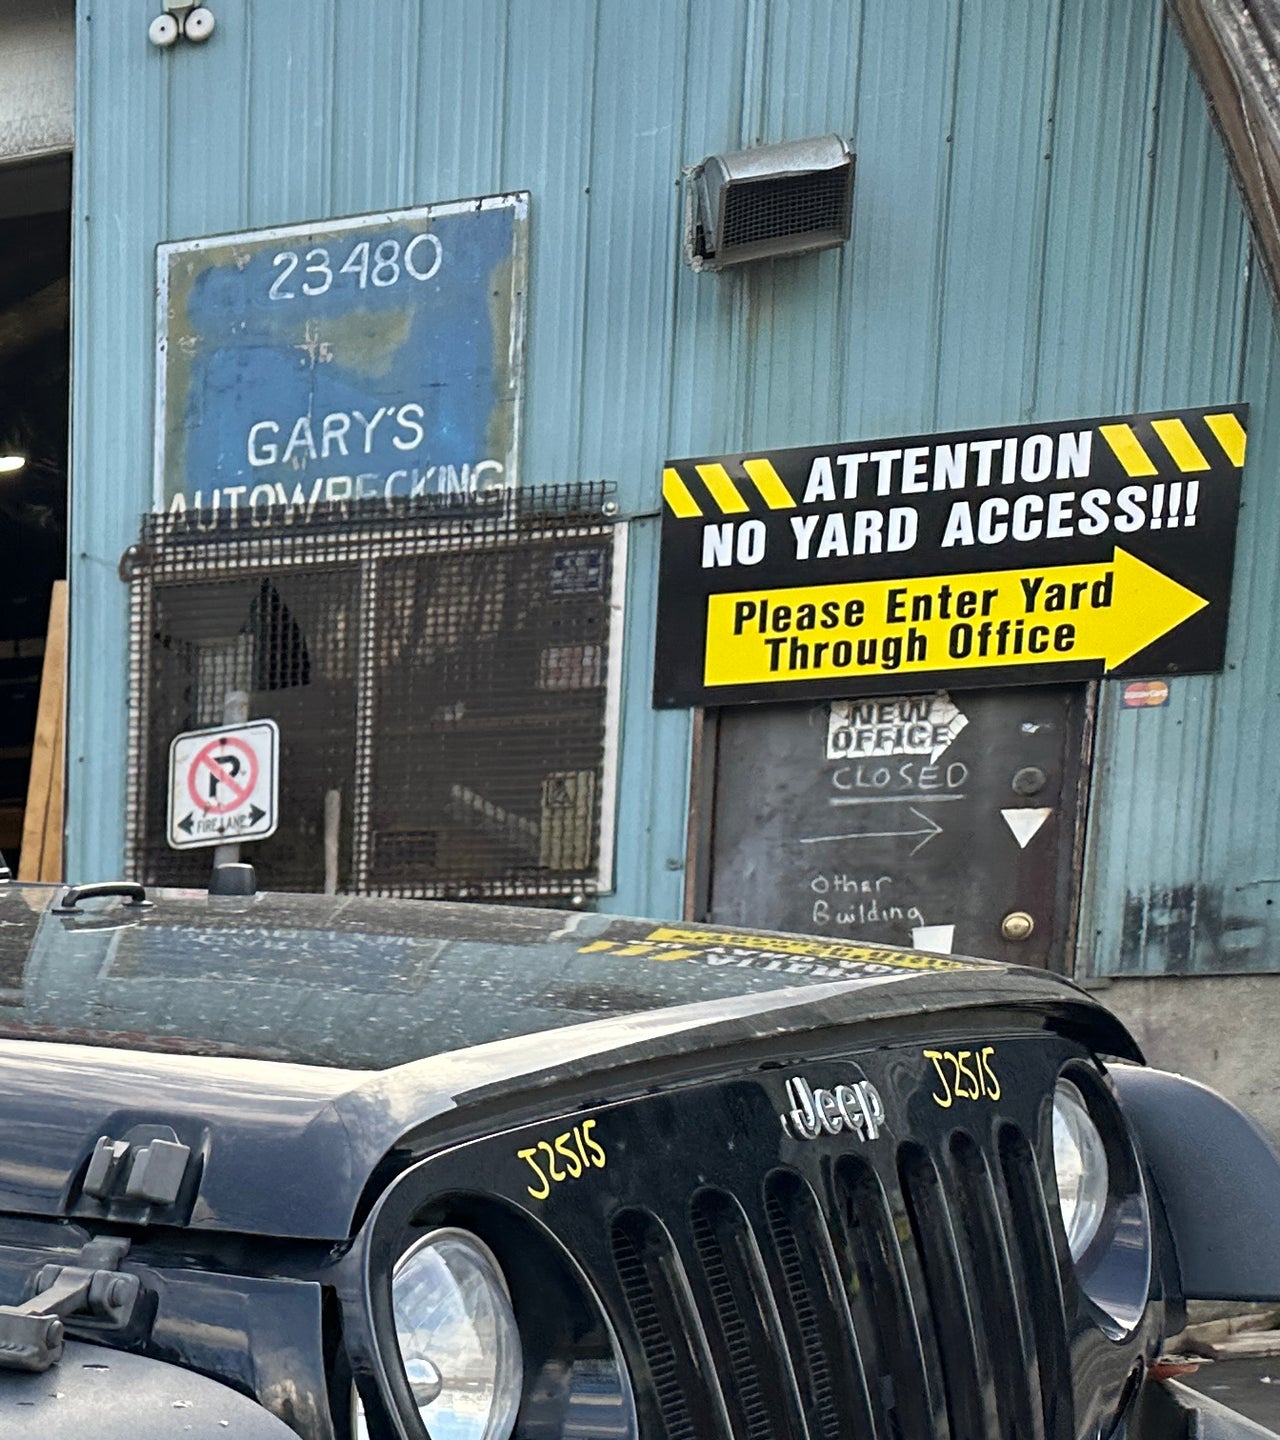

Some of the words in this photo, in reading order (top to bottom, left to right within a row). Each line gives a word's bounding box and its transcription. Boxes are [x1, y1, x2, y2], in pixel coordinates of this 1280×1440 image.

[269, 233, 443, 300] 23480
[247, 403, 425, 467] GARY'S
[804, 430, 1093, 503] ATTENTION
[702, 520, 766, 568] NO
[791, 510, 919, 561] YARD
[941, 481, 1201, 549] ACCESS!!!
[733, 598, 865, 636] Please
[886, 587, 995, 625] Enter
[1021, 572, 1115, 615] Yard
[765, 622, 927, 673] Through
[950, 620, 1077, 659] Office
[832, 762, 969, 790] CLOSED
[811, 874, 893, 894] Other
[813, 899, 925, 927] Building
[780, 1076, 886, 1143] Jeep
[923, 1047, 1002, 1109] J2515
[517, 1118, 607, 1200] J2515
